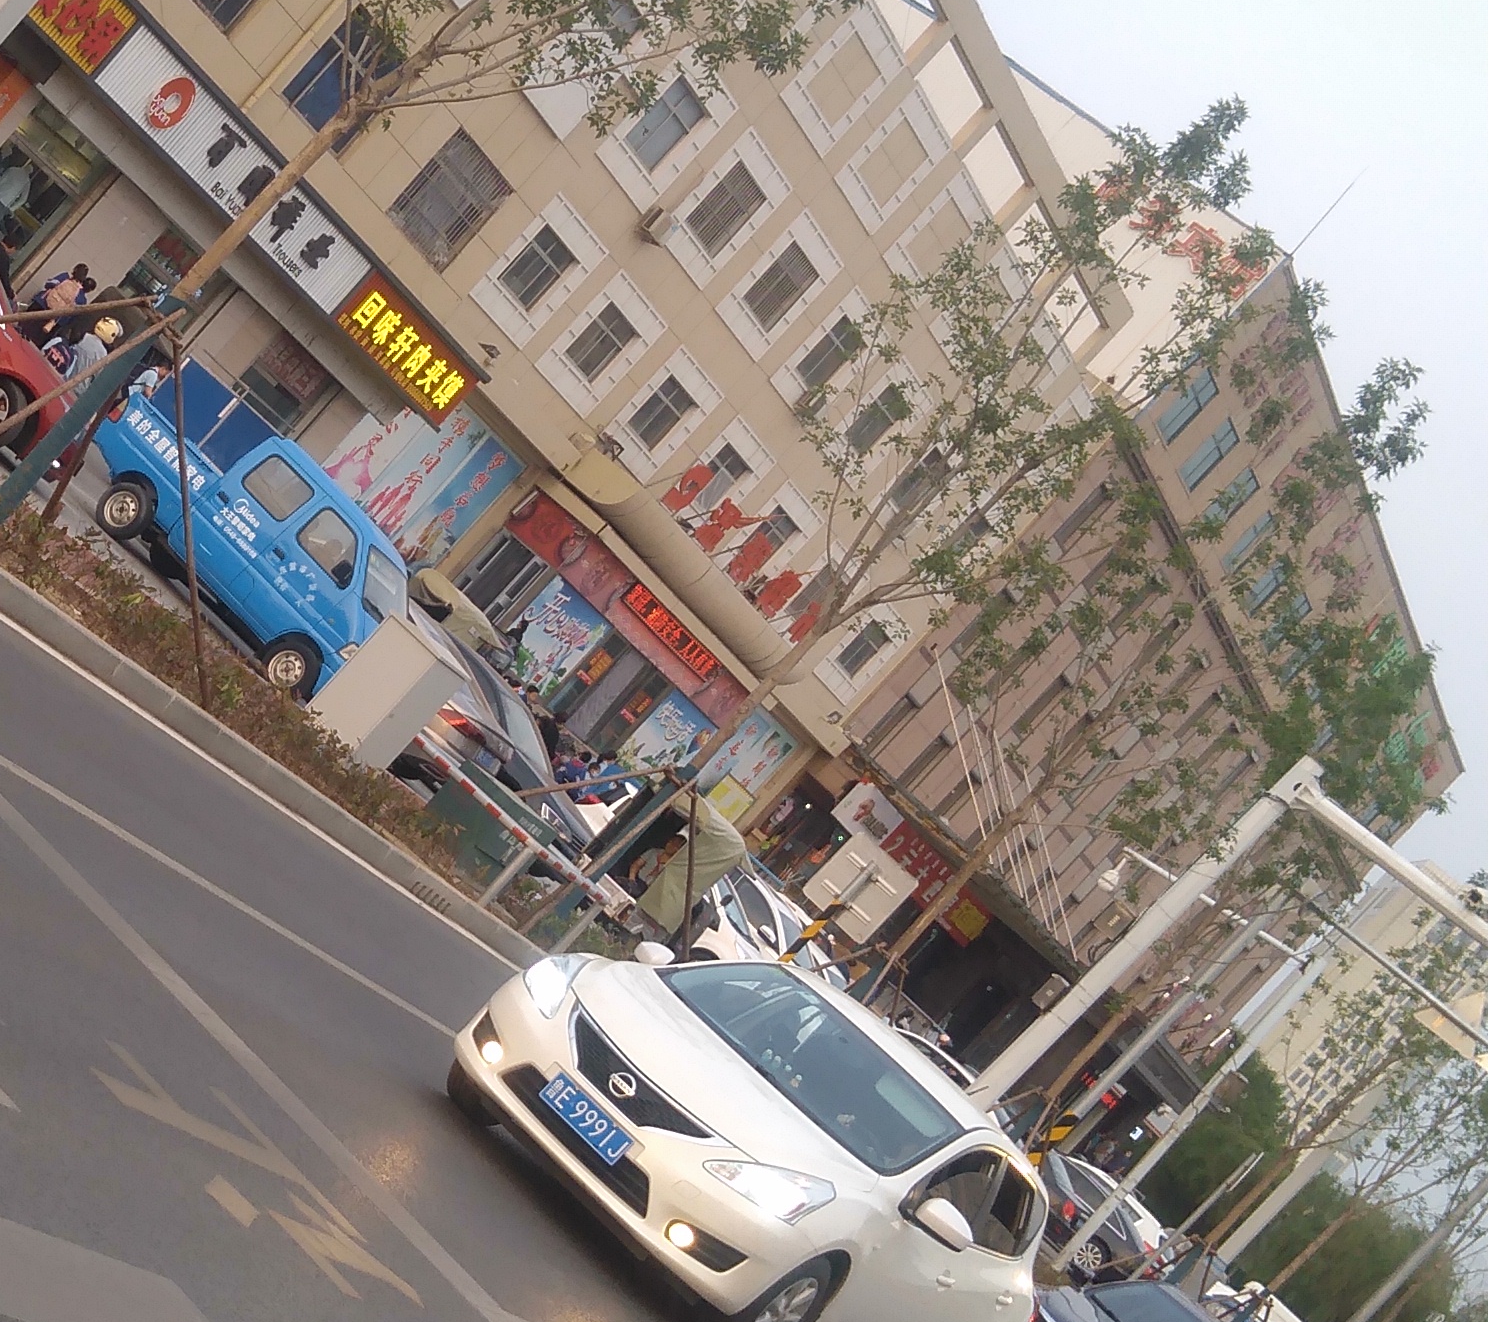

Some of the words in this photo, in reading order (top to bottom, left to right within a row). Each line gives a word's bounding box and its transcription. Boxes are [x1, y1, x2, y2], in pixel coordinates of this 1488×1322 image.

[208, 181, 227, 201] Bai
[270, 242, 304, 279] Trousers
[350, 289, 468, 411] 回味轩肉夹馍
